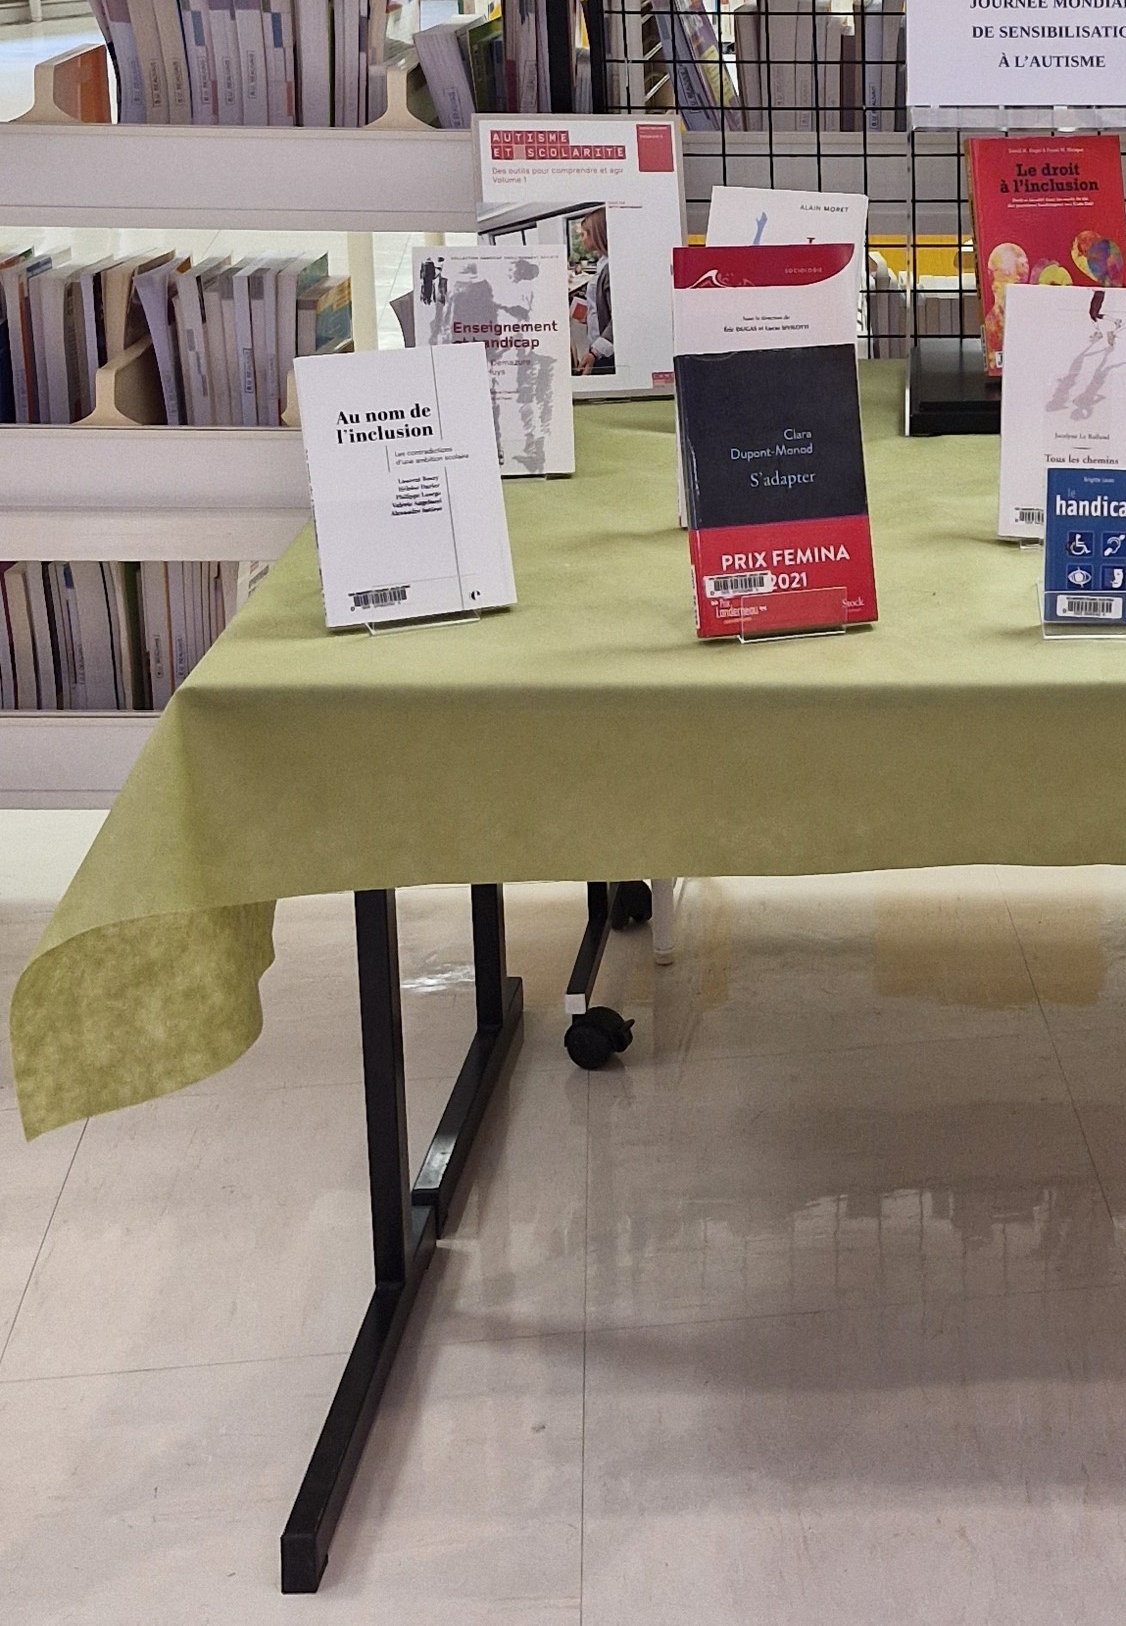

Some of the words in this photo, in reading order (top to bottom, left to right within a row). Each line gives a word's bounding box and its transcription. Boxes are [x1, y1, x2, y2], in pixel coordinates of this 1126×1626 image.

[972, 26, 994, 39] DE
[998, 53, 1010, 68] À
[1015, 55, 1106, 68] L’AUTISME
[492, 133, 567, 142] AUTISME
[494, 148, 511, 157] ET
[492, 167, 506, 175] Des
[532, 168, 549, 176] pour
[552, 167, 598, 176] comprendre
[1016, 164, 1036, 176] Le
[1042, 162, 1080, 176] droit
[1000, 179, 1009, 193] à
[1014, 178, 1098, 192] l'inclusion
[453, 320, 558, 336] Enseignement
[337, 411, 360, 425] Au
[366, 410, 405, 422] nom
[411, 403, 431, 417] de
[784, 429, 812, 441] Clara
[730, 443, 813, 462] Dupont-Monod
[1045, 454, 1065, 462] Tous
[1069, 455, 1079, 463] les
[1083, 455, 1118, 464] chemins
[1068, 488, 1075, 498] le
[722, 552, 767, 571] PRIX
[772, 544, 850, 566] FEMINA
[770, 572, 808, 590] 2021
[720, 599, 730, 607] Prix
[842, 598, 864, 608] Stock
[716, 606, 759, 618] Landerneau
